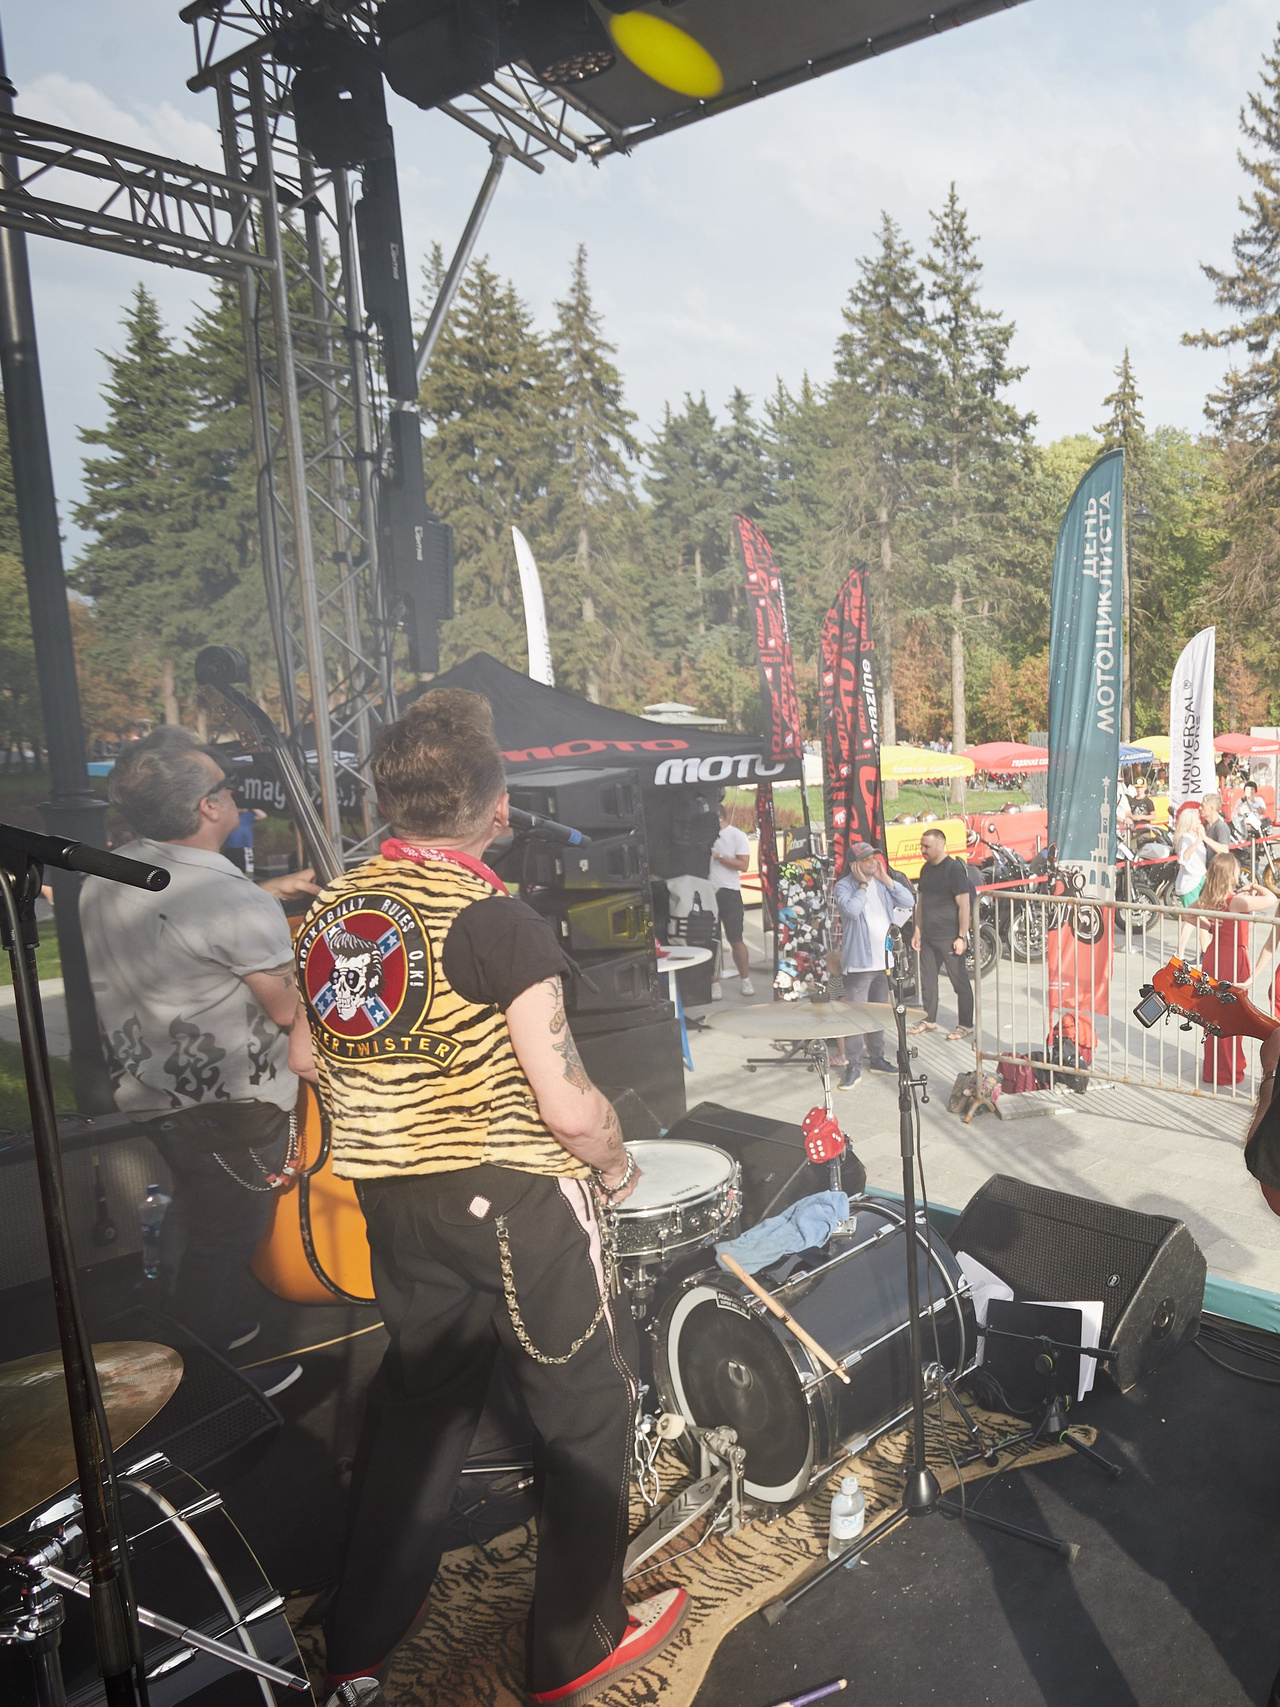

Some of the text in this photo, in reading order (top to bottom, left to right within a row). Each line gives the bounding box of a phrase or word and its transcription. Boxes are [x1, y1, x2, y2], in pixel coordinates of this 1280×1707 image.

[300, 898, 365, 969] ROCKABILLY
[380, 898, 416, 933] RULES
[346, 1037, 450, 1058] TWISTER
